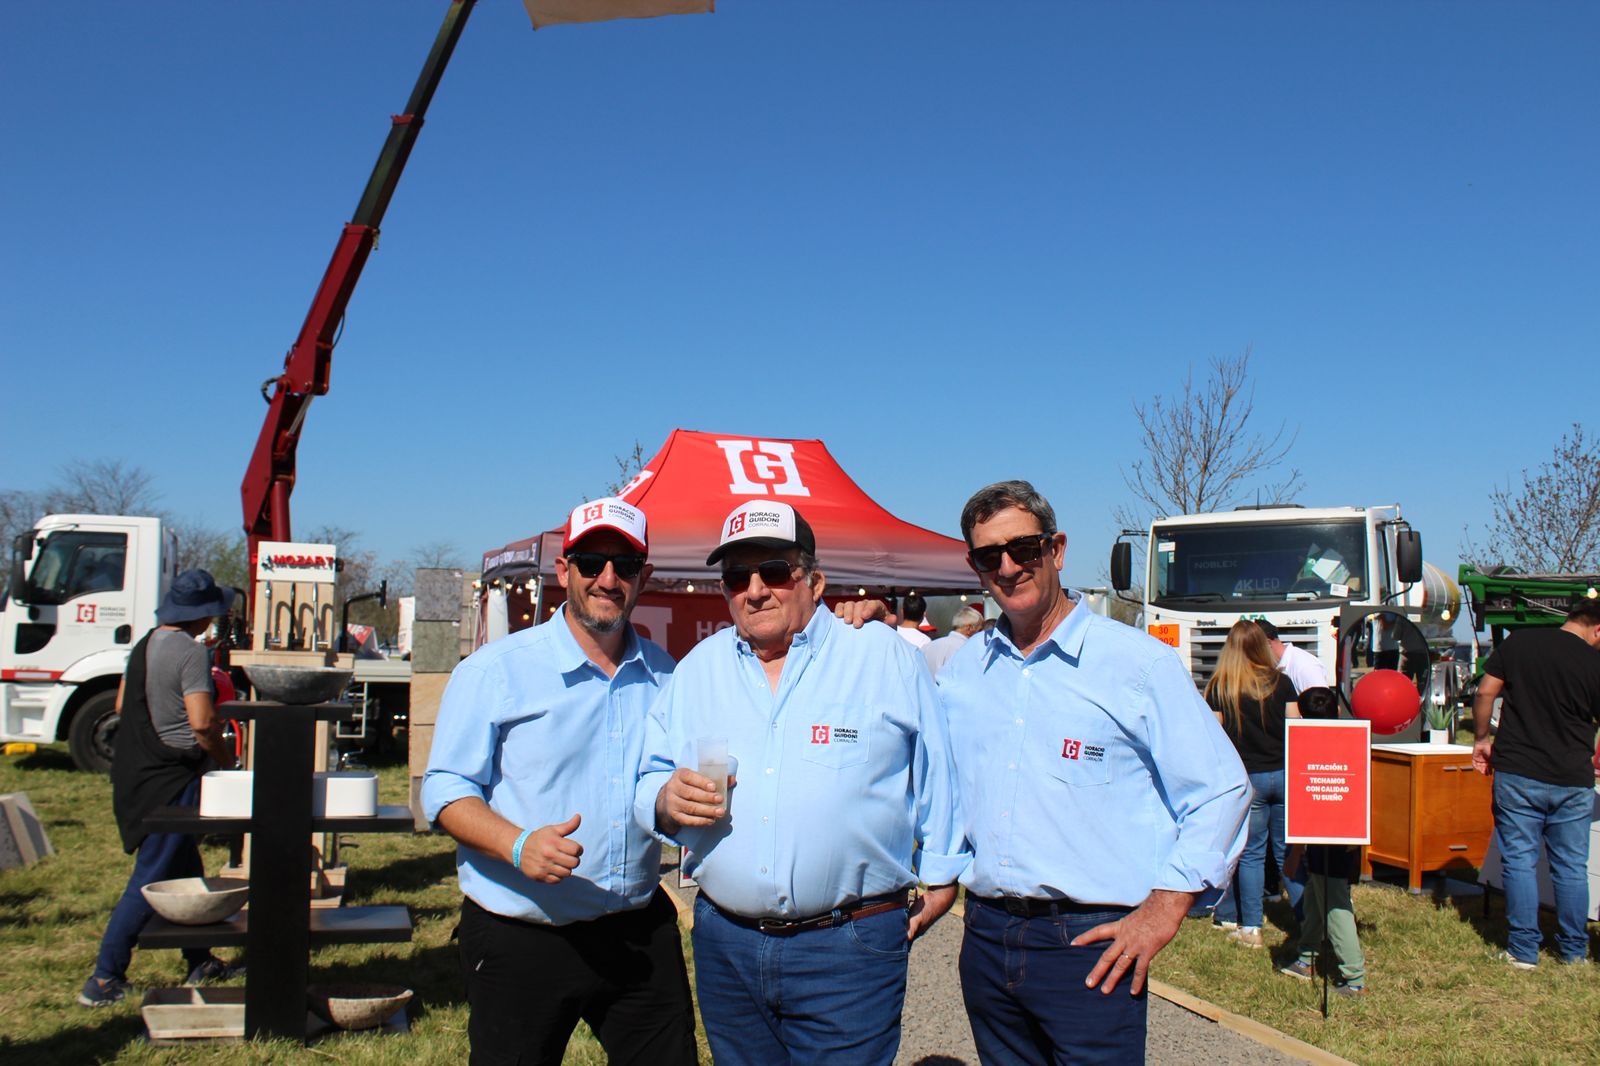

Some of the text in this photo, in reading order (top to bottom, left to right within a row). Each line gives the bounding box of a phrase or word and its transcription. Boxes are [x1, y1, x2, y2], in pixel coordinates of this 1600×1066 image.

[608, 504, 636, 517] HORACIO
[608, 509, 635, 521] GUIDONI
[1255, 578, 1280, 589] LED
[1158, 626, 1169, 635] 30
[1307, 763, 1343, 771] ESTACIÓN
[1320, 785, 1350, 793] CALIDAD
[1321, 793, 1343, 801] SUEÑO
